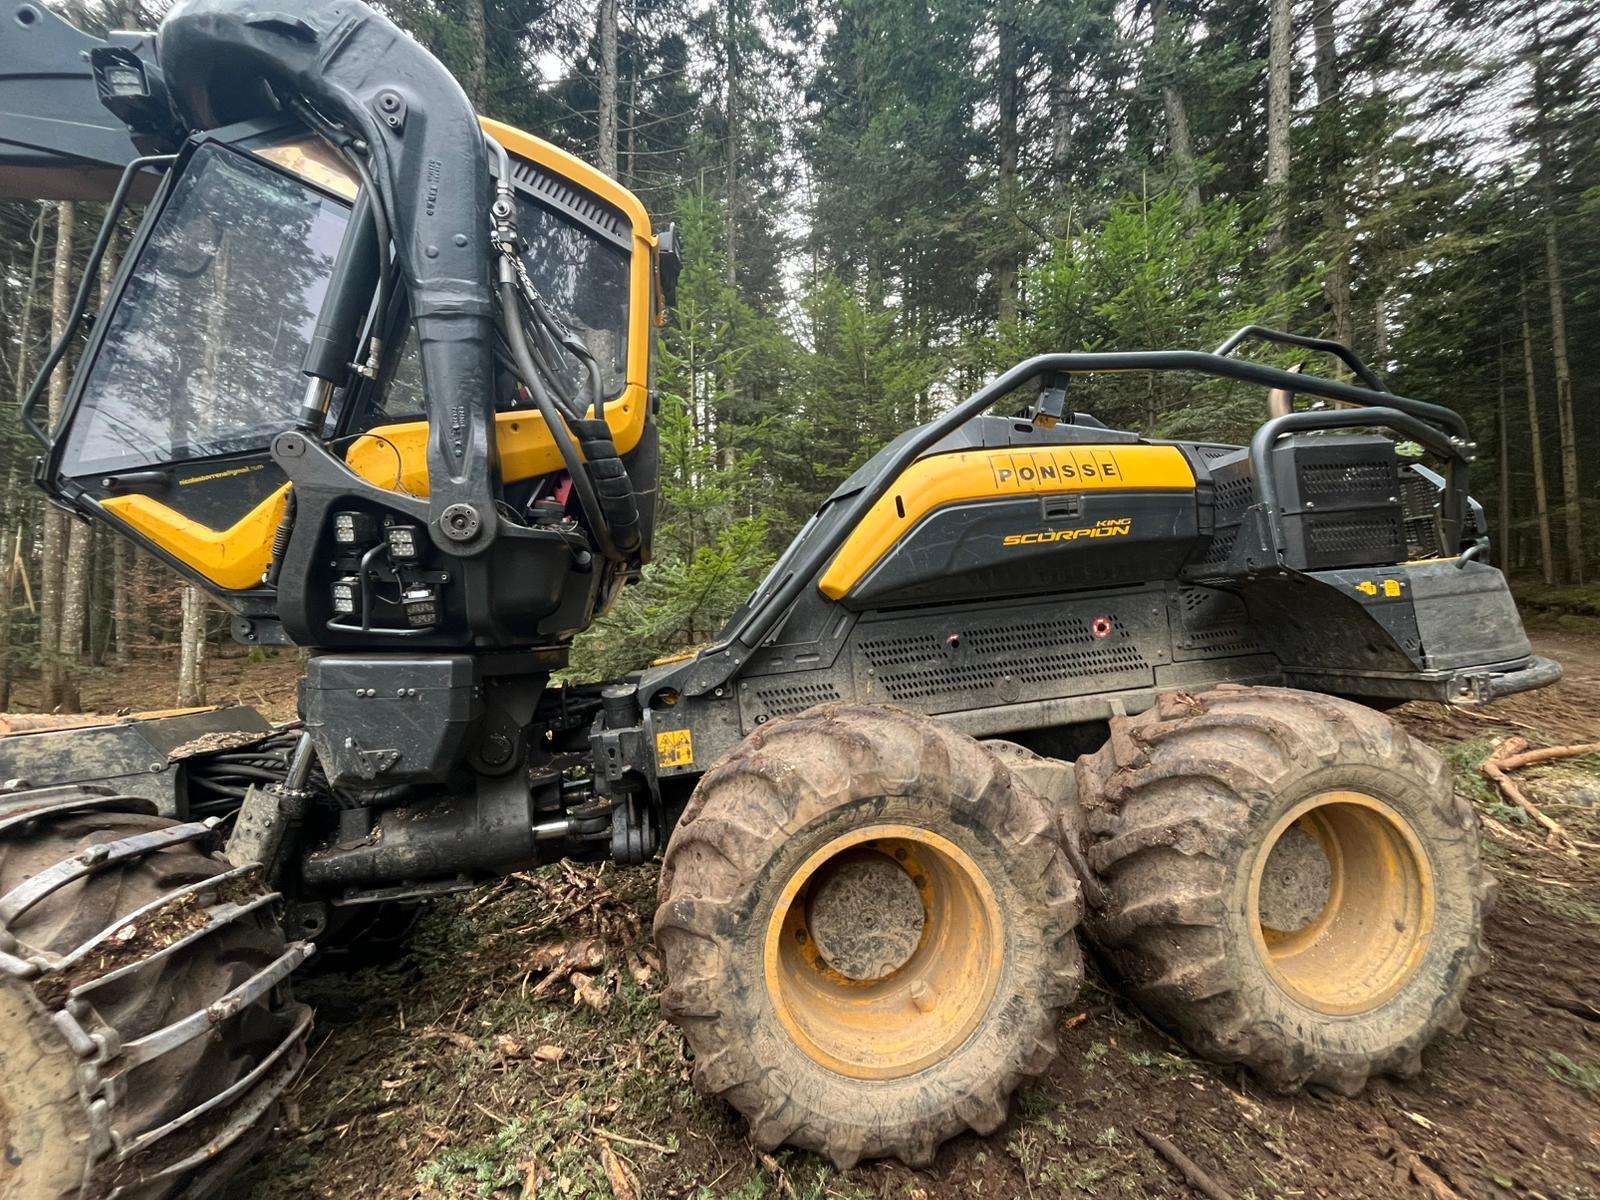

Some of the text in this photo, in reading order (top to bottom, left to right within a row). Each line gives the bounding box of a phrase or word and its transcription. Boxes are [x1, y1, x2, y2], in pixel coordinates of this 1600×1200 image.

[998, 463, 1117, 483] PONSSE
[1096, 517, 1132, 527] KING
[1002, 525, 1131, 546] SCORPION
